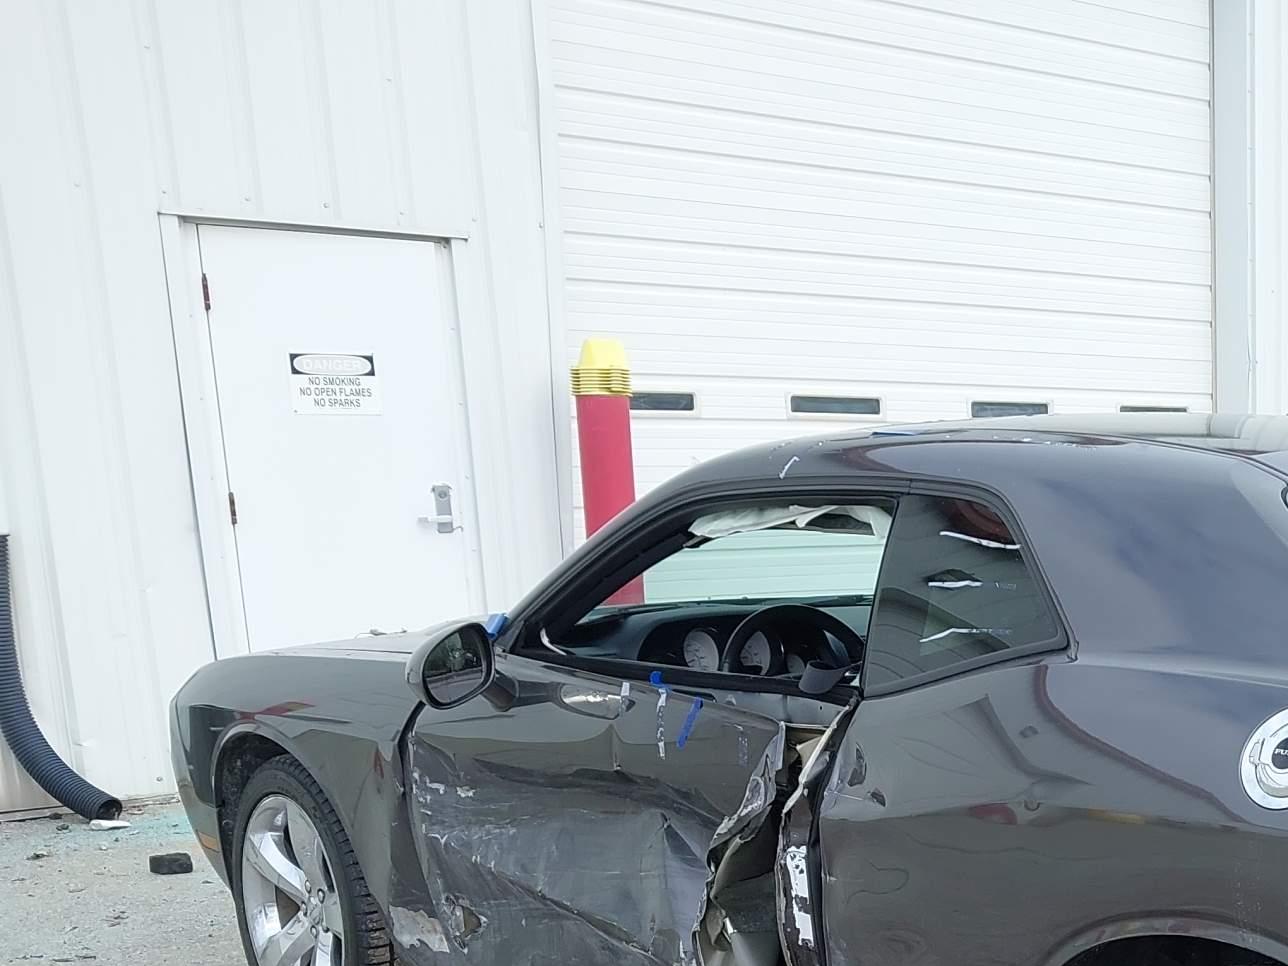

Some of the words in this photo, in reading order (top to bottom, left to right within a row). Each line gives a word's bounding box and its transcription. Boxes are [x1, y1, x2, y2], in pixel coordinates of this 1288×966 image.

[303, 359, 362, 371] DANGER
[308, 376, 321, 386] NO
[322, 376, 361, 386] SMOKING
[299, 387, 312, 397] NO
[314, 387, 337, 397] OPEN
[338, 388, 372, 398] FLAMES
[313, 397, 326, 408] NO
[328, 398, 361, 408] SPARKS
